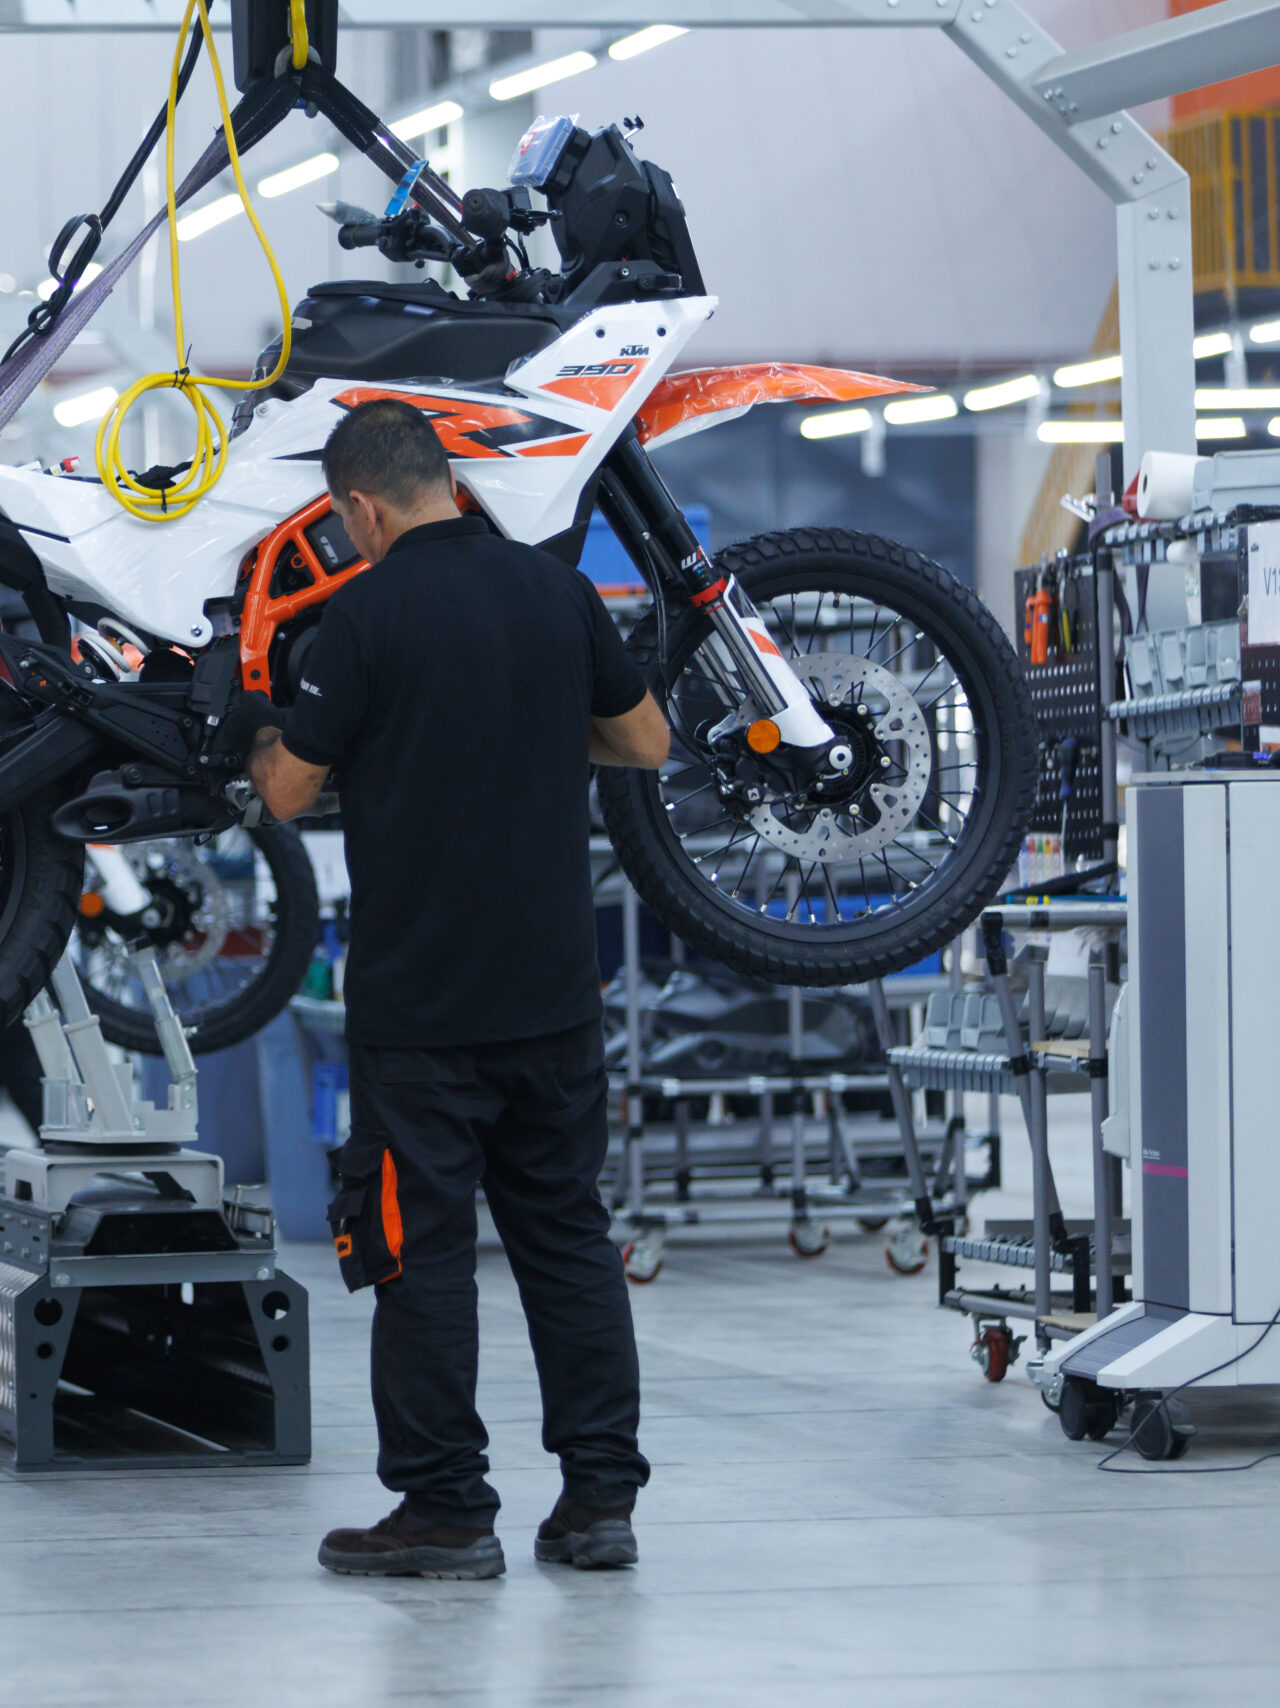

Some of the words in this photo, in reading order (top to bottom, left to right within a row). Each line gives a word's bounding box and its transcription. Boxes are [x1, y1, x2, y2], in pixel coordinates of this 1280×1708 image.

[619, 345, 649, 356] KTM
[556, 363, 635, 376] 390
[1263, 567, 1280, 596] V1
